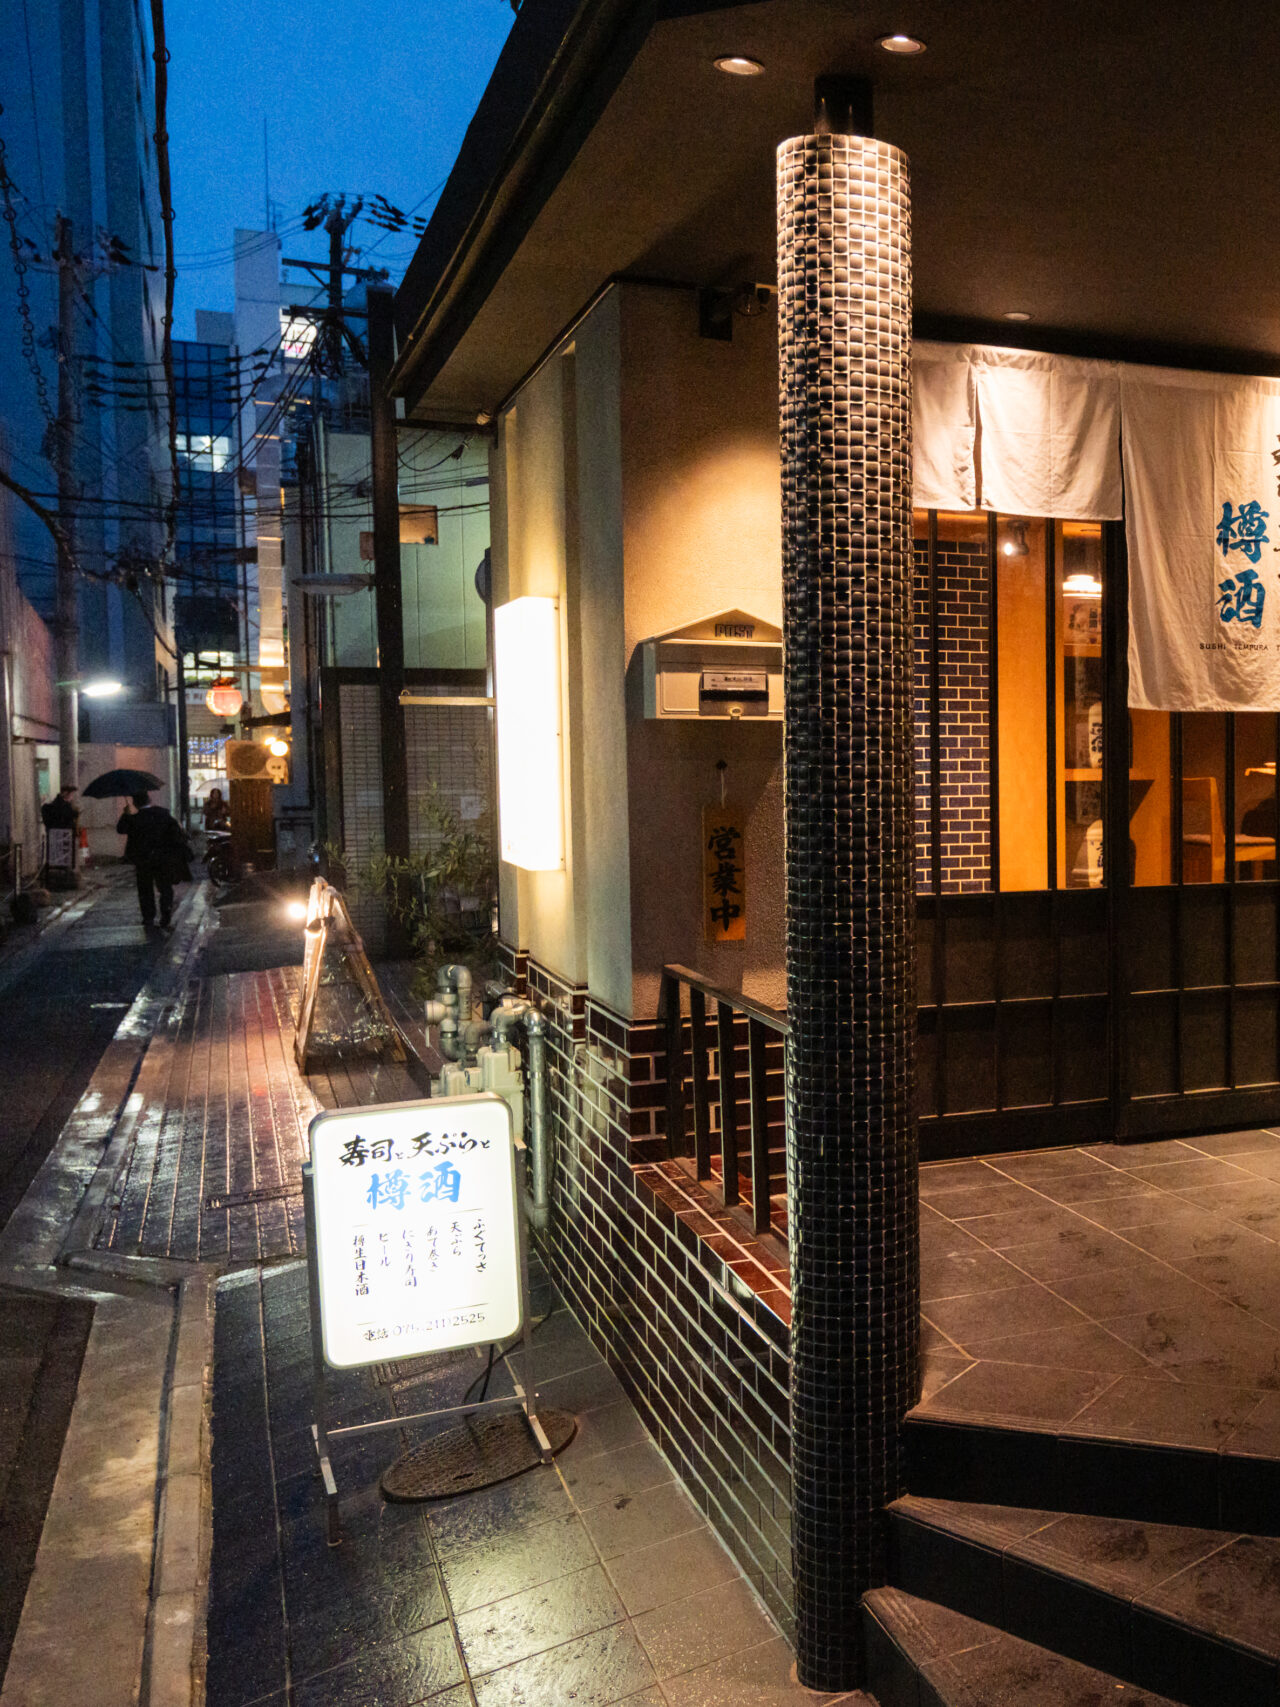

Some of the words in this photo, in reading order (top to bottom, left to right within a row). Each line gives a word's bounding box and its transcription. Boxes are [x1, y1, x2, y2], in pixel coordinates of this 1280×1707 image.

[1215, 500, 1270, 629] 樽酒
[714, 623, 755, 639] POST
[1199, 642, 1226, 651] SUSHI
[1234, 643, 1268, 651] TEMPURA
[707, 825, 741, 932] 営業中
[339, 1131, 490, 1167] 寿司と天ぷらと
[366, 1160, 462, 1211] 樽酒
